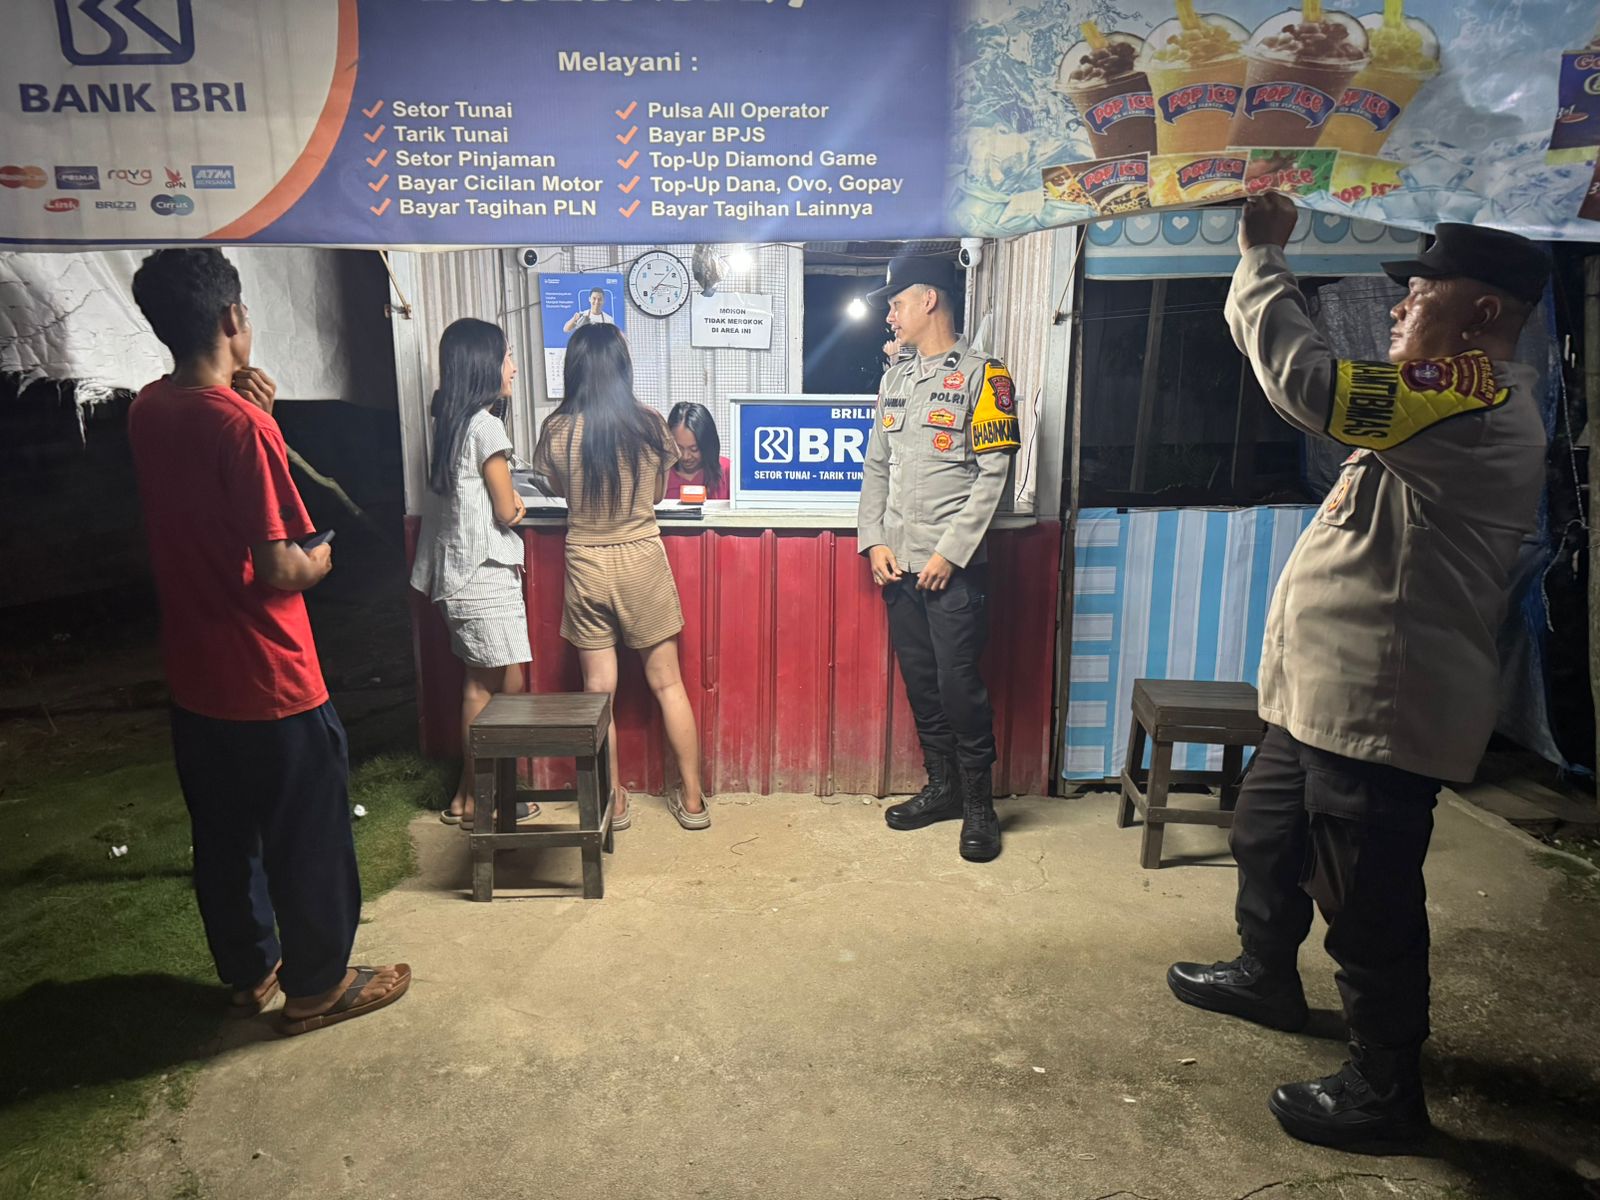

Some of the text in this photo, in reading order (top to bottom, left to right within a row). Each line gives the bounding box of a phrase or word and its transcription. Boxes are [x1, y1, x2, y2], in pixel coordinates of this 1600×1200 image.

[558, 51, 681, 77] Melayani
[19, 82, 248, 114] BANK BRI
[1168, 86, 1204, 113] POP
[1252, 85, 1292, 106] POP
[392, 100, 513, 119] Setor Tunai
[648, 101, 830, 122] Pulsa All Operator
[393, 125, 509, 143] Tarik Tunai
[648, 126, 766, 147] Bayar BPJS
[396, 150, 556, 171] Setor Pinjaman
[649, 150, 878, 171] Top-Up Diamond Game
[195, 169, 232, 179] ATM
[1084, 162, 1114, 191] POP
[1181, 160, 1212, 183] POP
[165, 181, 187, 189] GPN
[398, 174, 603, 194] Bayar Cicilan Motor
[650, 175, 904, 196] Top-Up Dana, Ovo, Gopay
[156, 201, 189, 209] Cirrus
[399, 199, 597, 219] Bayar Tagihan PLN
[651, 200, 873, 220] Bayar Tagihan Lainnya
[929, 392, 966, 405] POLRI
[754, 470, 783, 480] SETOR
[785, 470, 811, 480] TUNAI
[819, 471, 844, 480] TARIK
